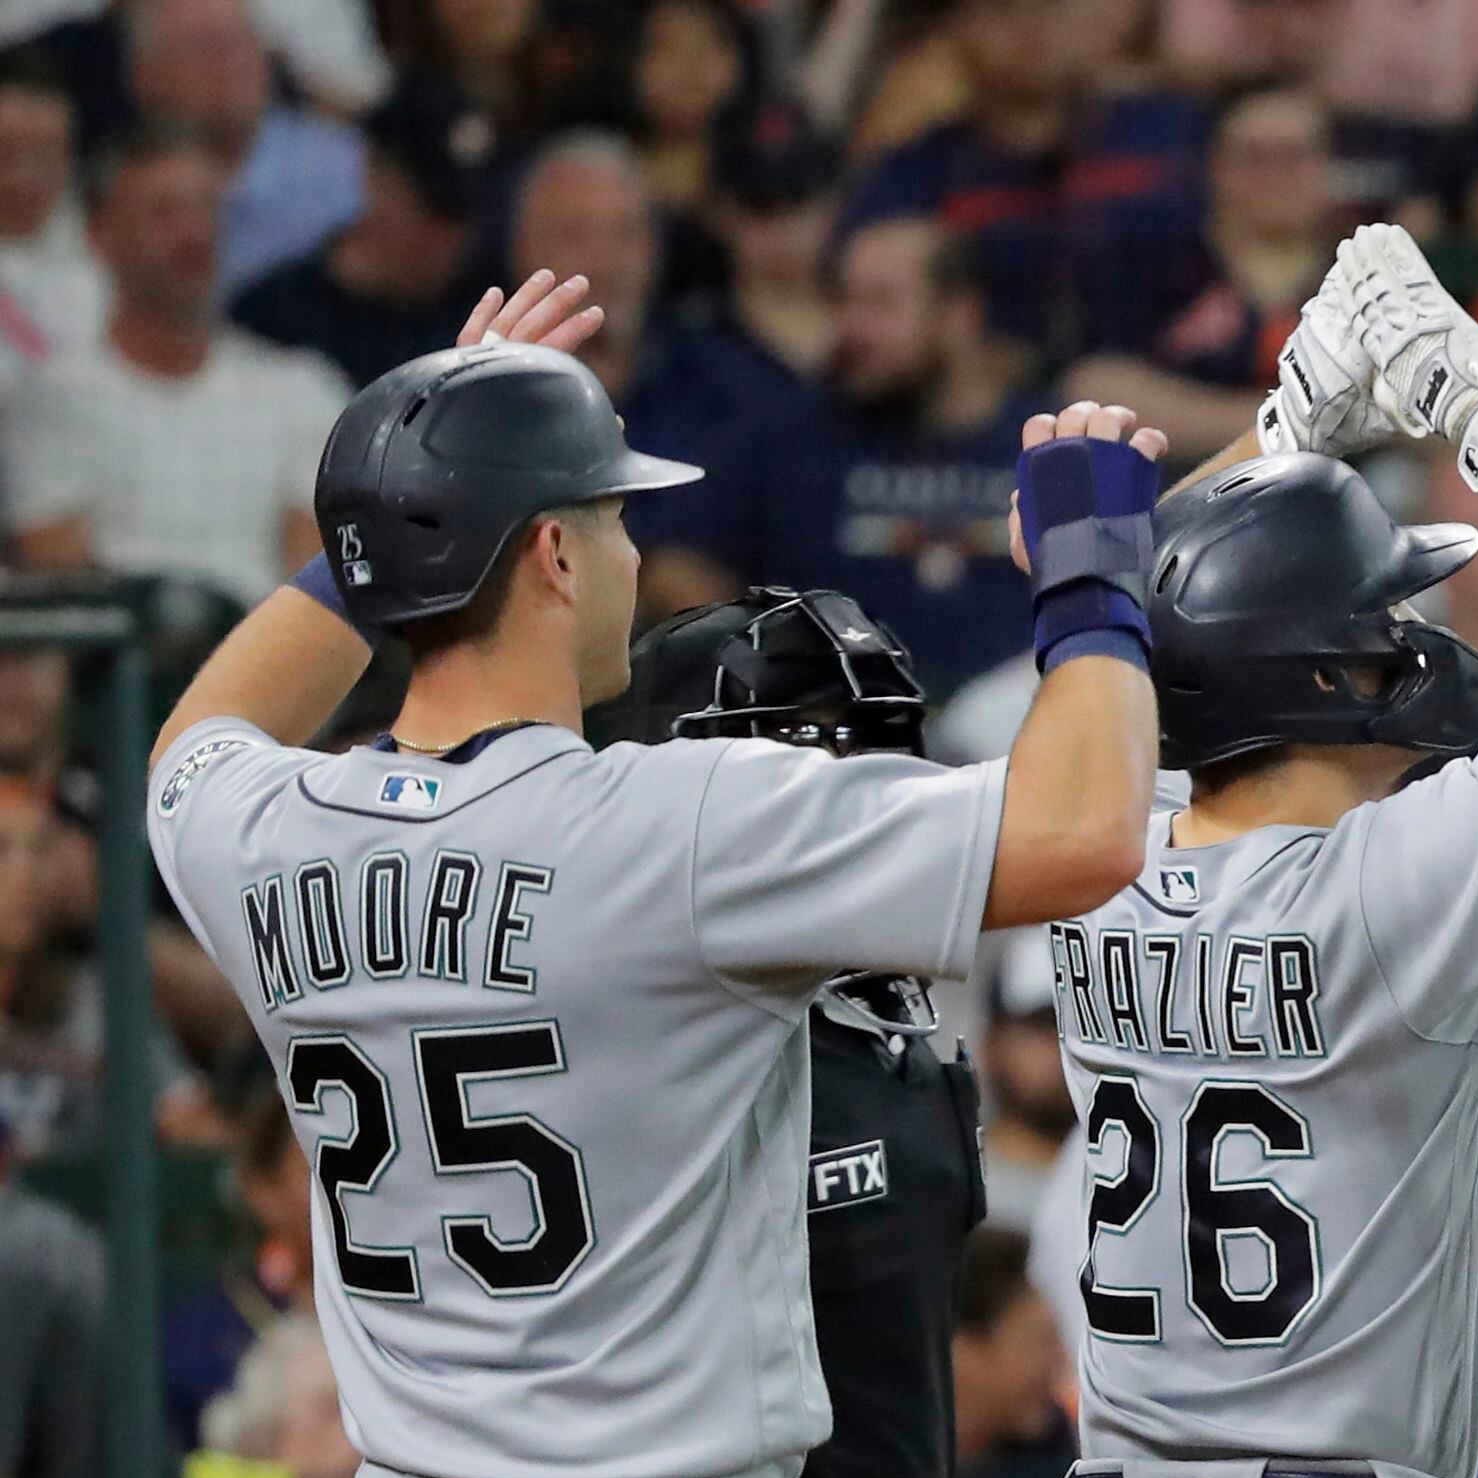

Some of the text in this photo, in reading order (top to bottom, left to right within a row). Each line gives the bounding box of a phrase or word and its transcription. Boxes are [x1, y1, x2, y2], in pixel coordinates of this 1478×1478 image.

[337, 523, 363, 560] 25
[241, 847, 556, 1014] MOORE
[1050, 921, 1328, 1058] FRAZIER
[286, 1017, 598, 1304] 25
[813, 1150, 885, 1202] FTX
[1077, 1072, 1320, 1348] 26
